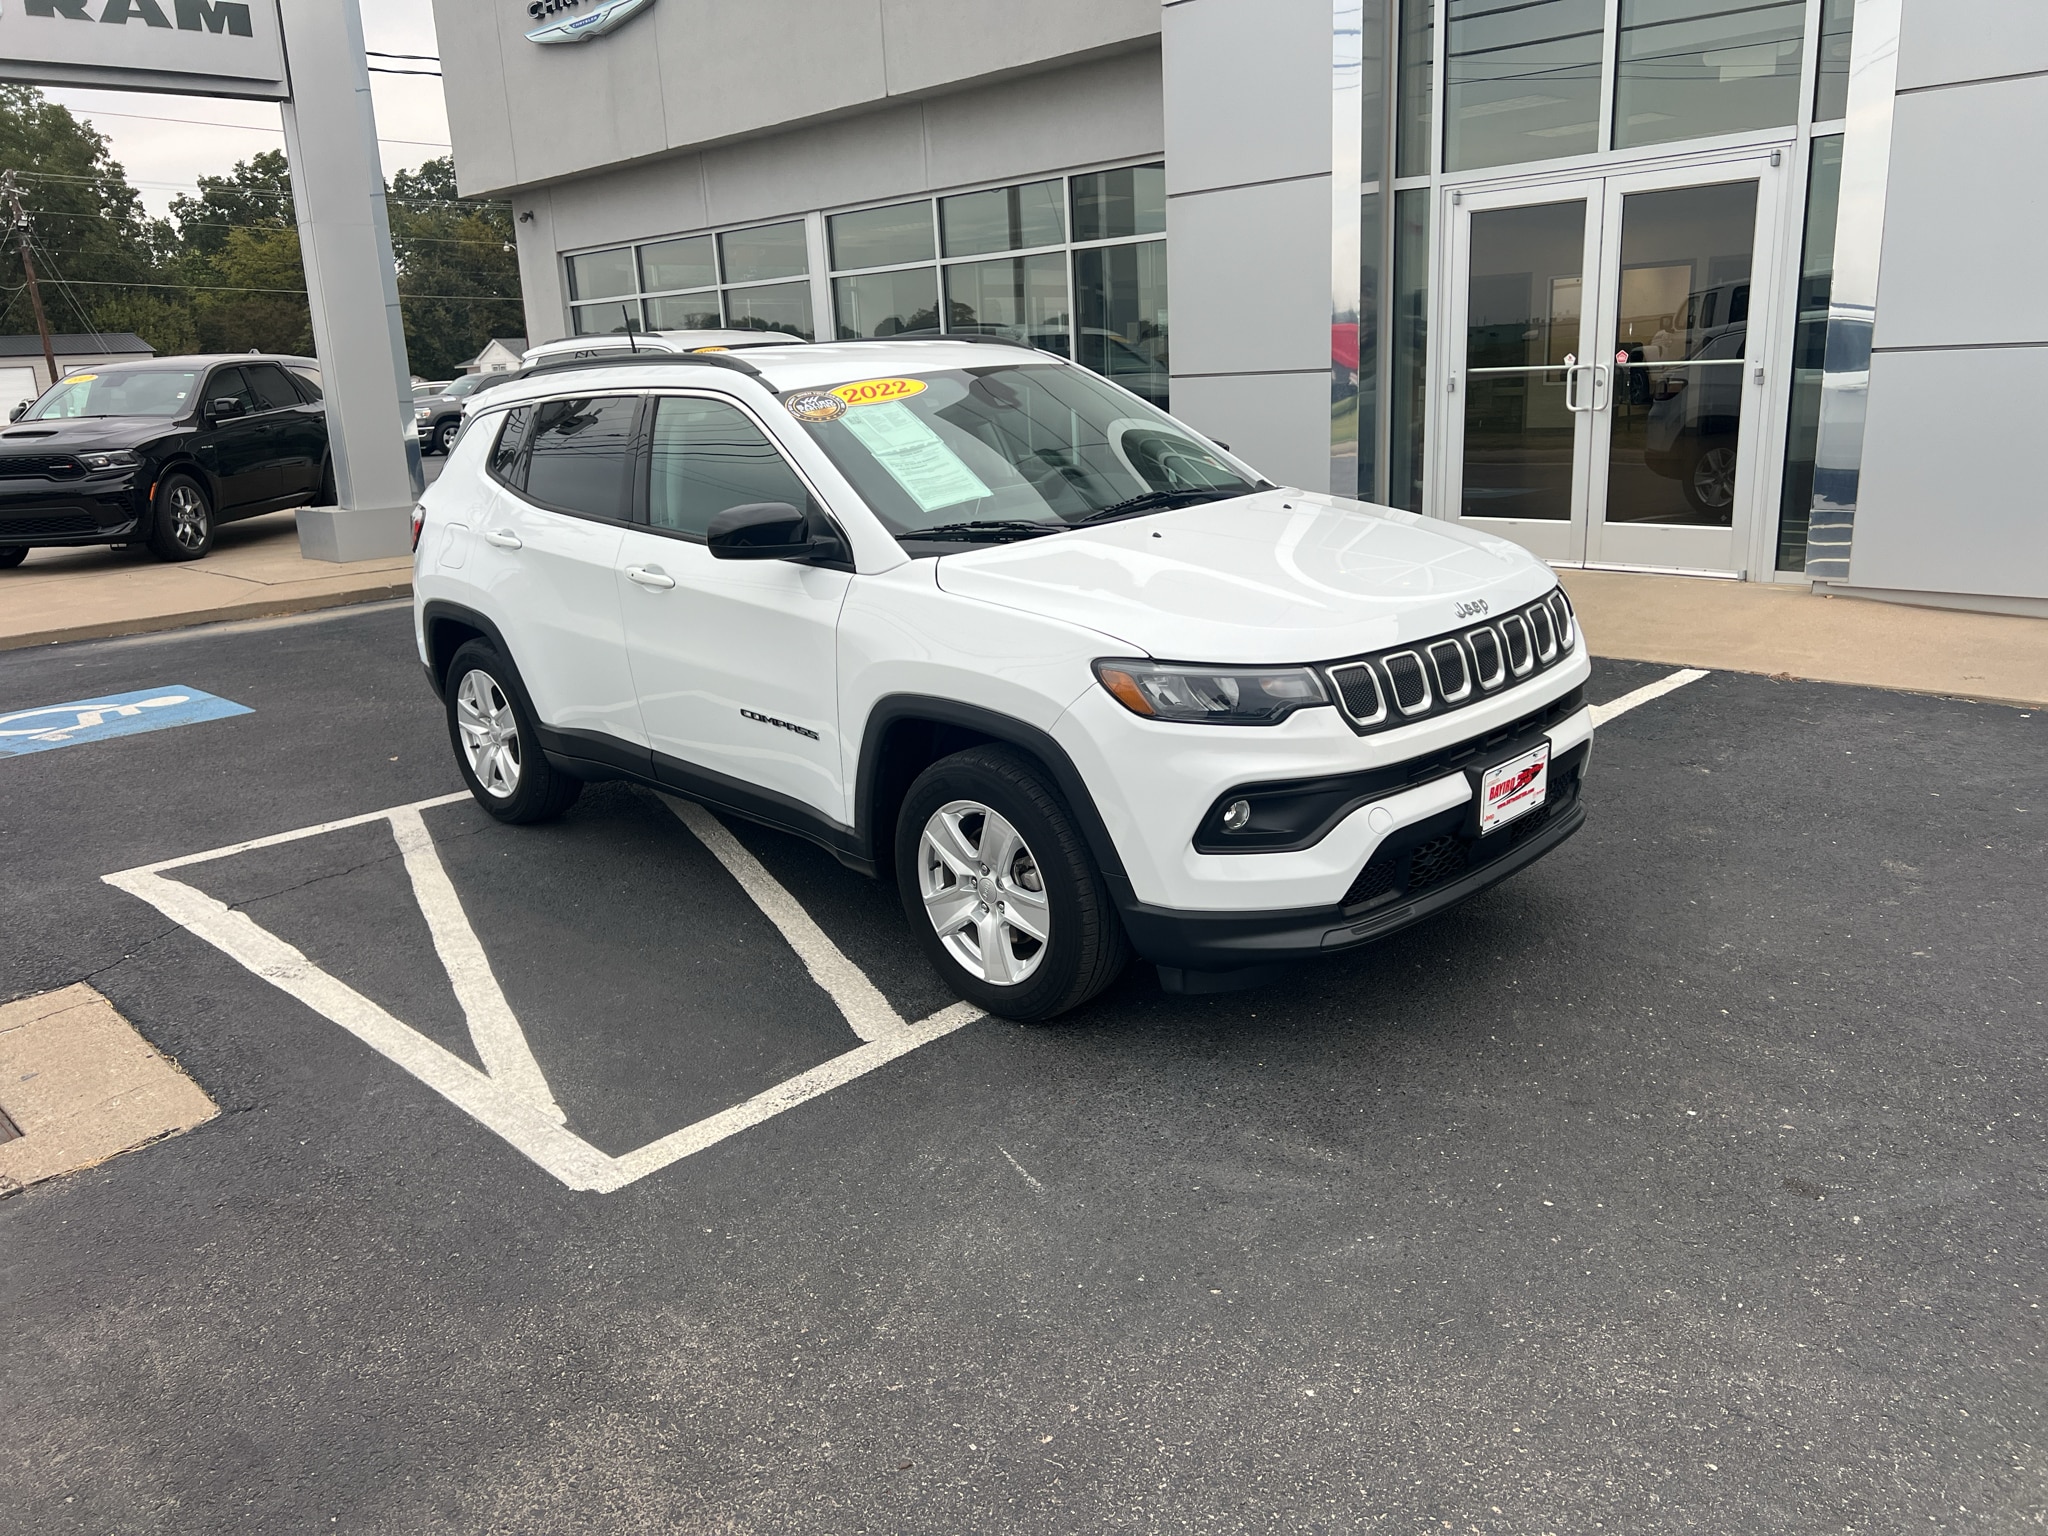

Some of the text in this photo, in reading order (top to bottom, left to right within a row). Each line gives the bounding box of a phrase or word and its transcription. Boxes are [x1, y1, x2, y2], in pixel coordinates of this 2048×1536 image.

[26, 0, 253, 37] RAM
[842, 380, 911, 403] 2022
[1454, 599, 1489, 618] Jeep
[740, 709, 820, 741] COMPASS
[1489, 777, 1516, 801] BAYIRD
